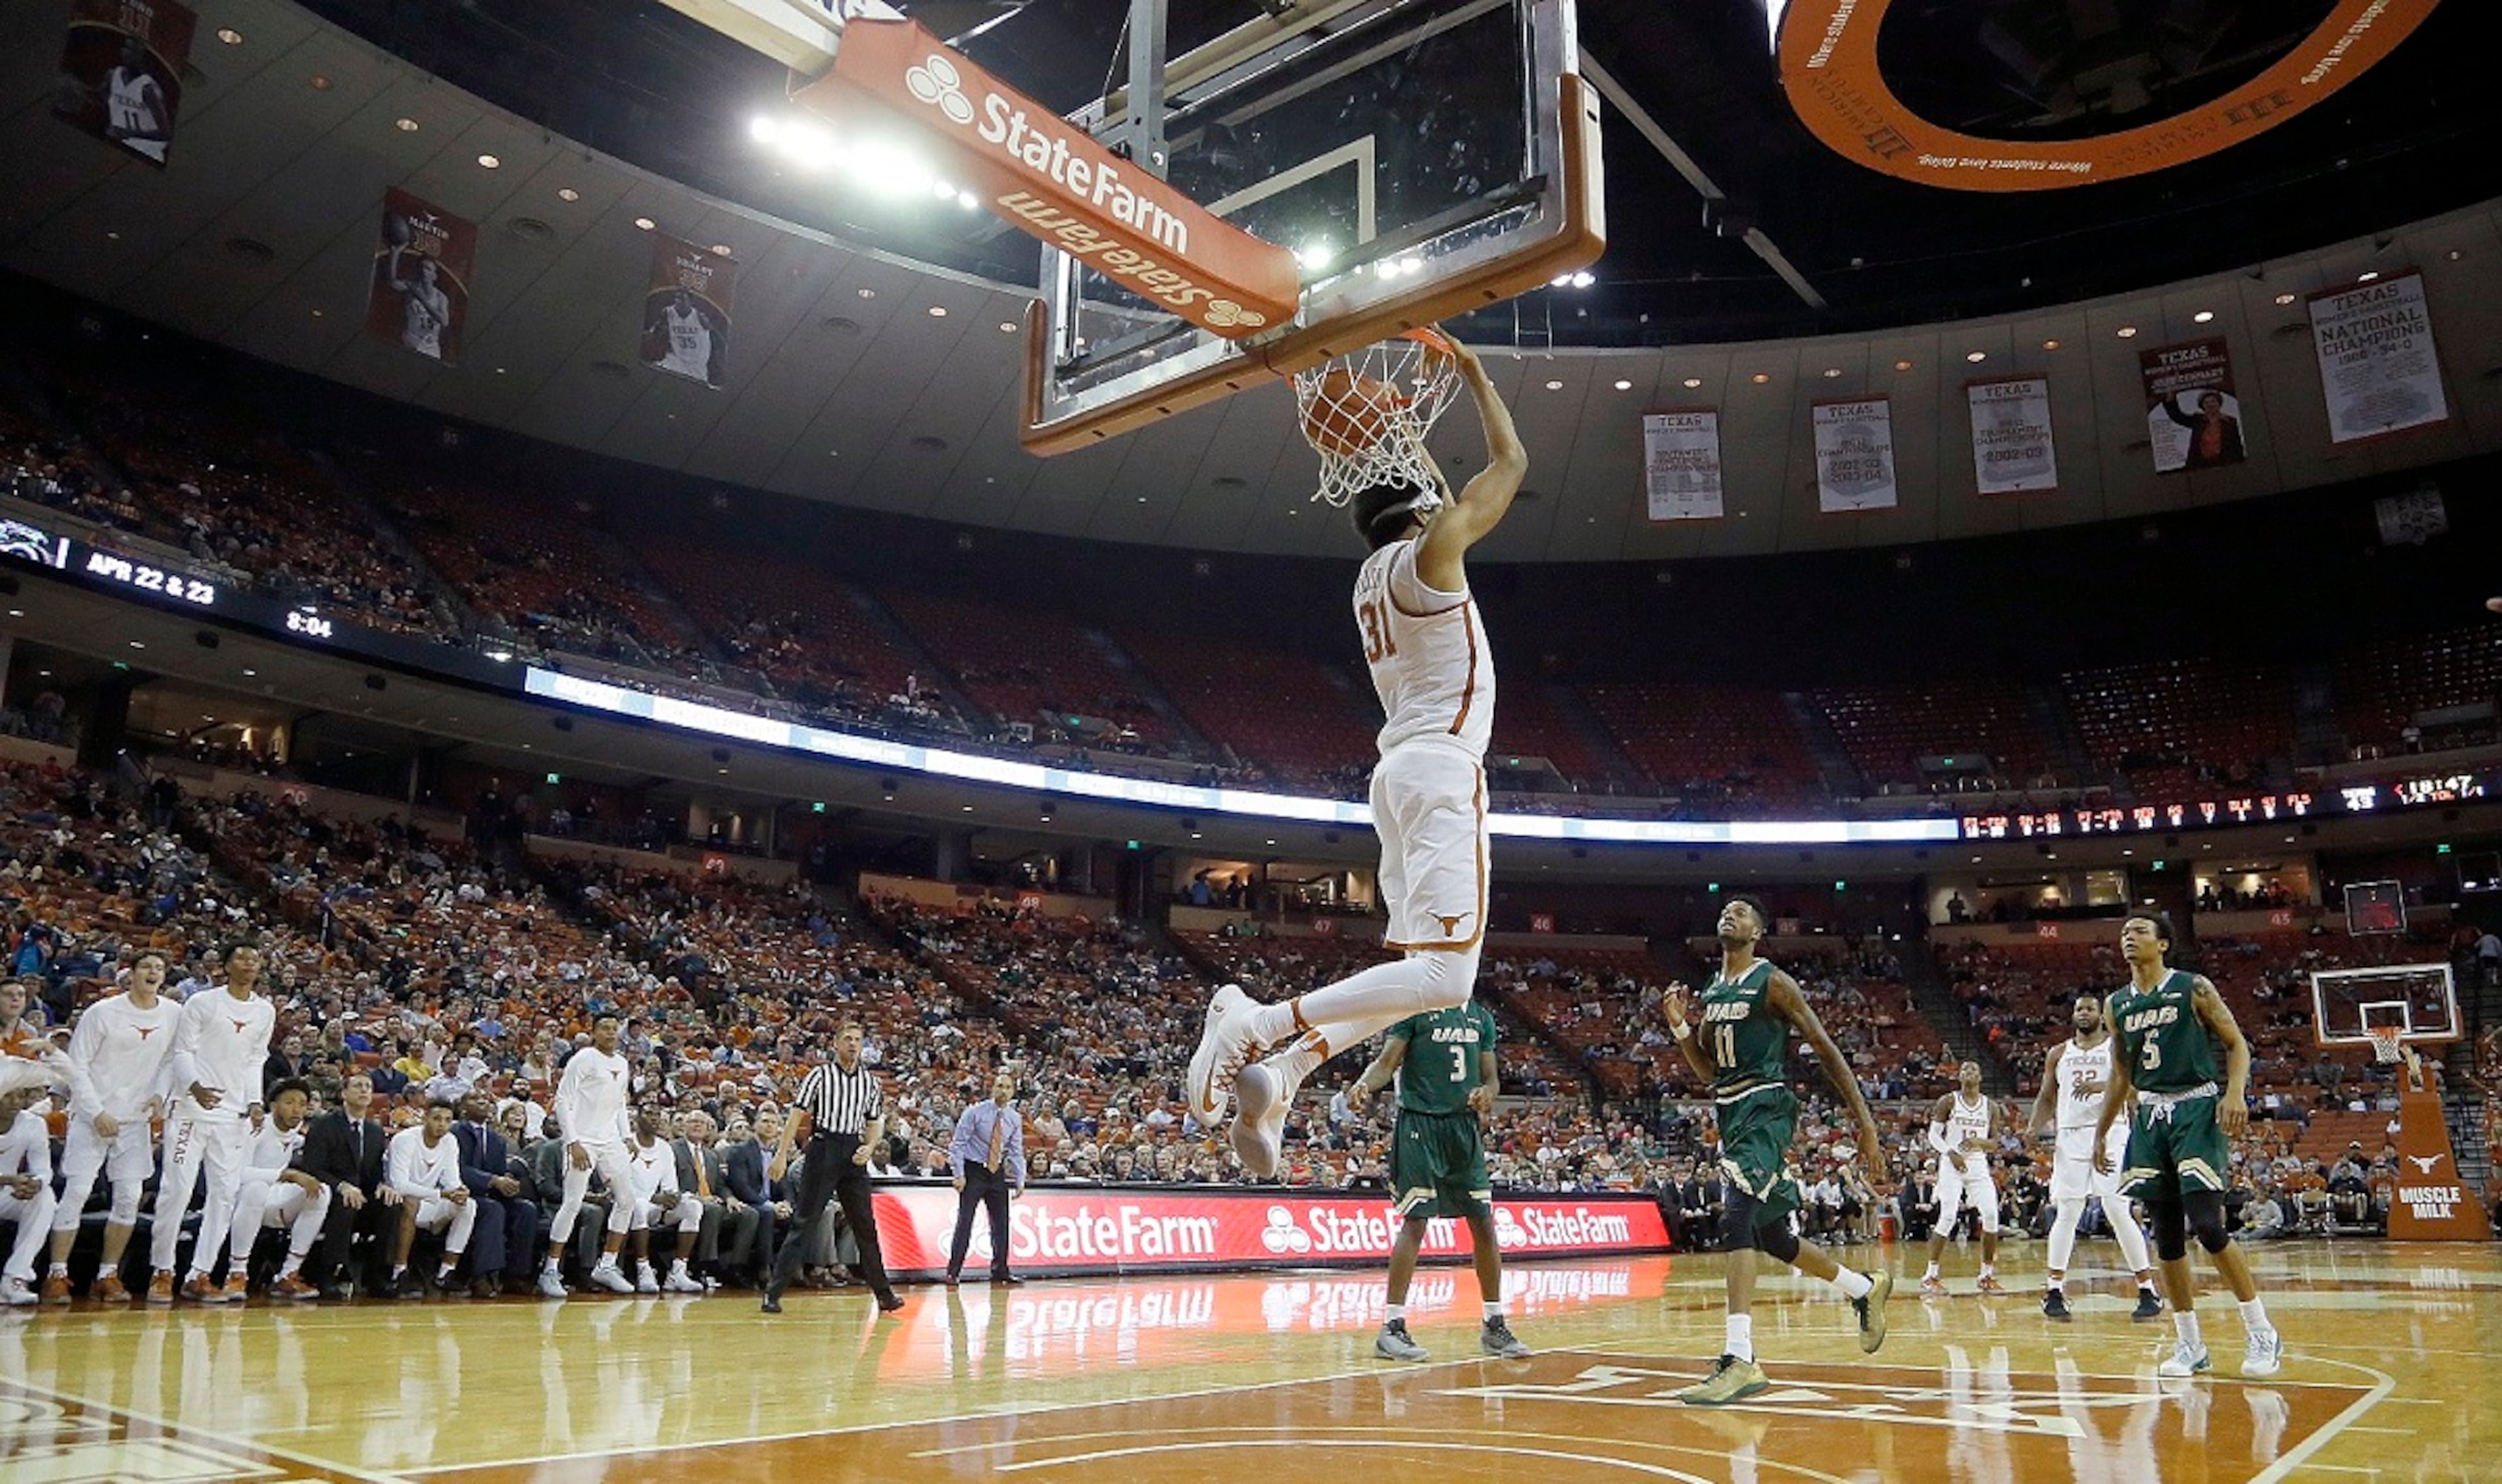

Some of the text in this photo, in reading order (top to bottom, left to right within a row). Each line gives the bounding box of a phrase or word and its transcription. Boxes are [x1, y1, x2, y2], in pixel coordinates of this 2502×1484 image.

[124, 109, 141, 133] 11
[2333, 283, 2398, 311] TEXAS
[2322, 309, 2421, 342] NATIONAL
[680, 335, 697, 350] 35
[2323, 321, 2424, 356] CHAMPIONS
[2158, 345, 2209, 365] TEXAS
[1985, 384, 2031, 396] TEXAS
[1659, 415, 1702, 426] TEXAS
[1829, 405, 1873, 417] TEXAS
[86, 552, 214, 605] APR 22 & 23
[287, 612, 332, 638] 8:04
[1360, 595, 1396, 663] 31
[1314, 920, 1331, 933] 47
[1533, 917, 1550, 932] 46
[2039, 925, 2058, 938] 44
[1706, 1001, 1751, 1021] UAB
[2124, 1005, 2178, 1032] UAB
[1431, 1028, 1480, 1042] UAB
[1715, 1023, 1737, 1068] 11
[2142, 1027, 2161, 1070] 5
[1449, 1045, 1466, 1082] 3
[2065, 1055, 2107, 1066] TEXAS
[1956, 1117, 1987, 1127] TEXAS
[173, 1121, 194, 1165] TEXAS
[2399, 1186, 2461, 1203] MUSCLE
